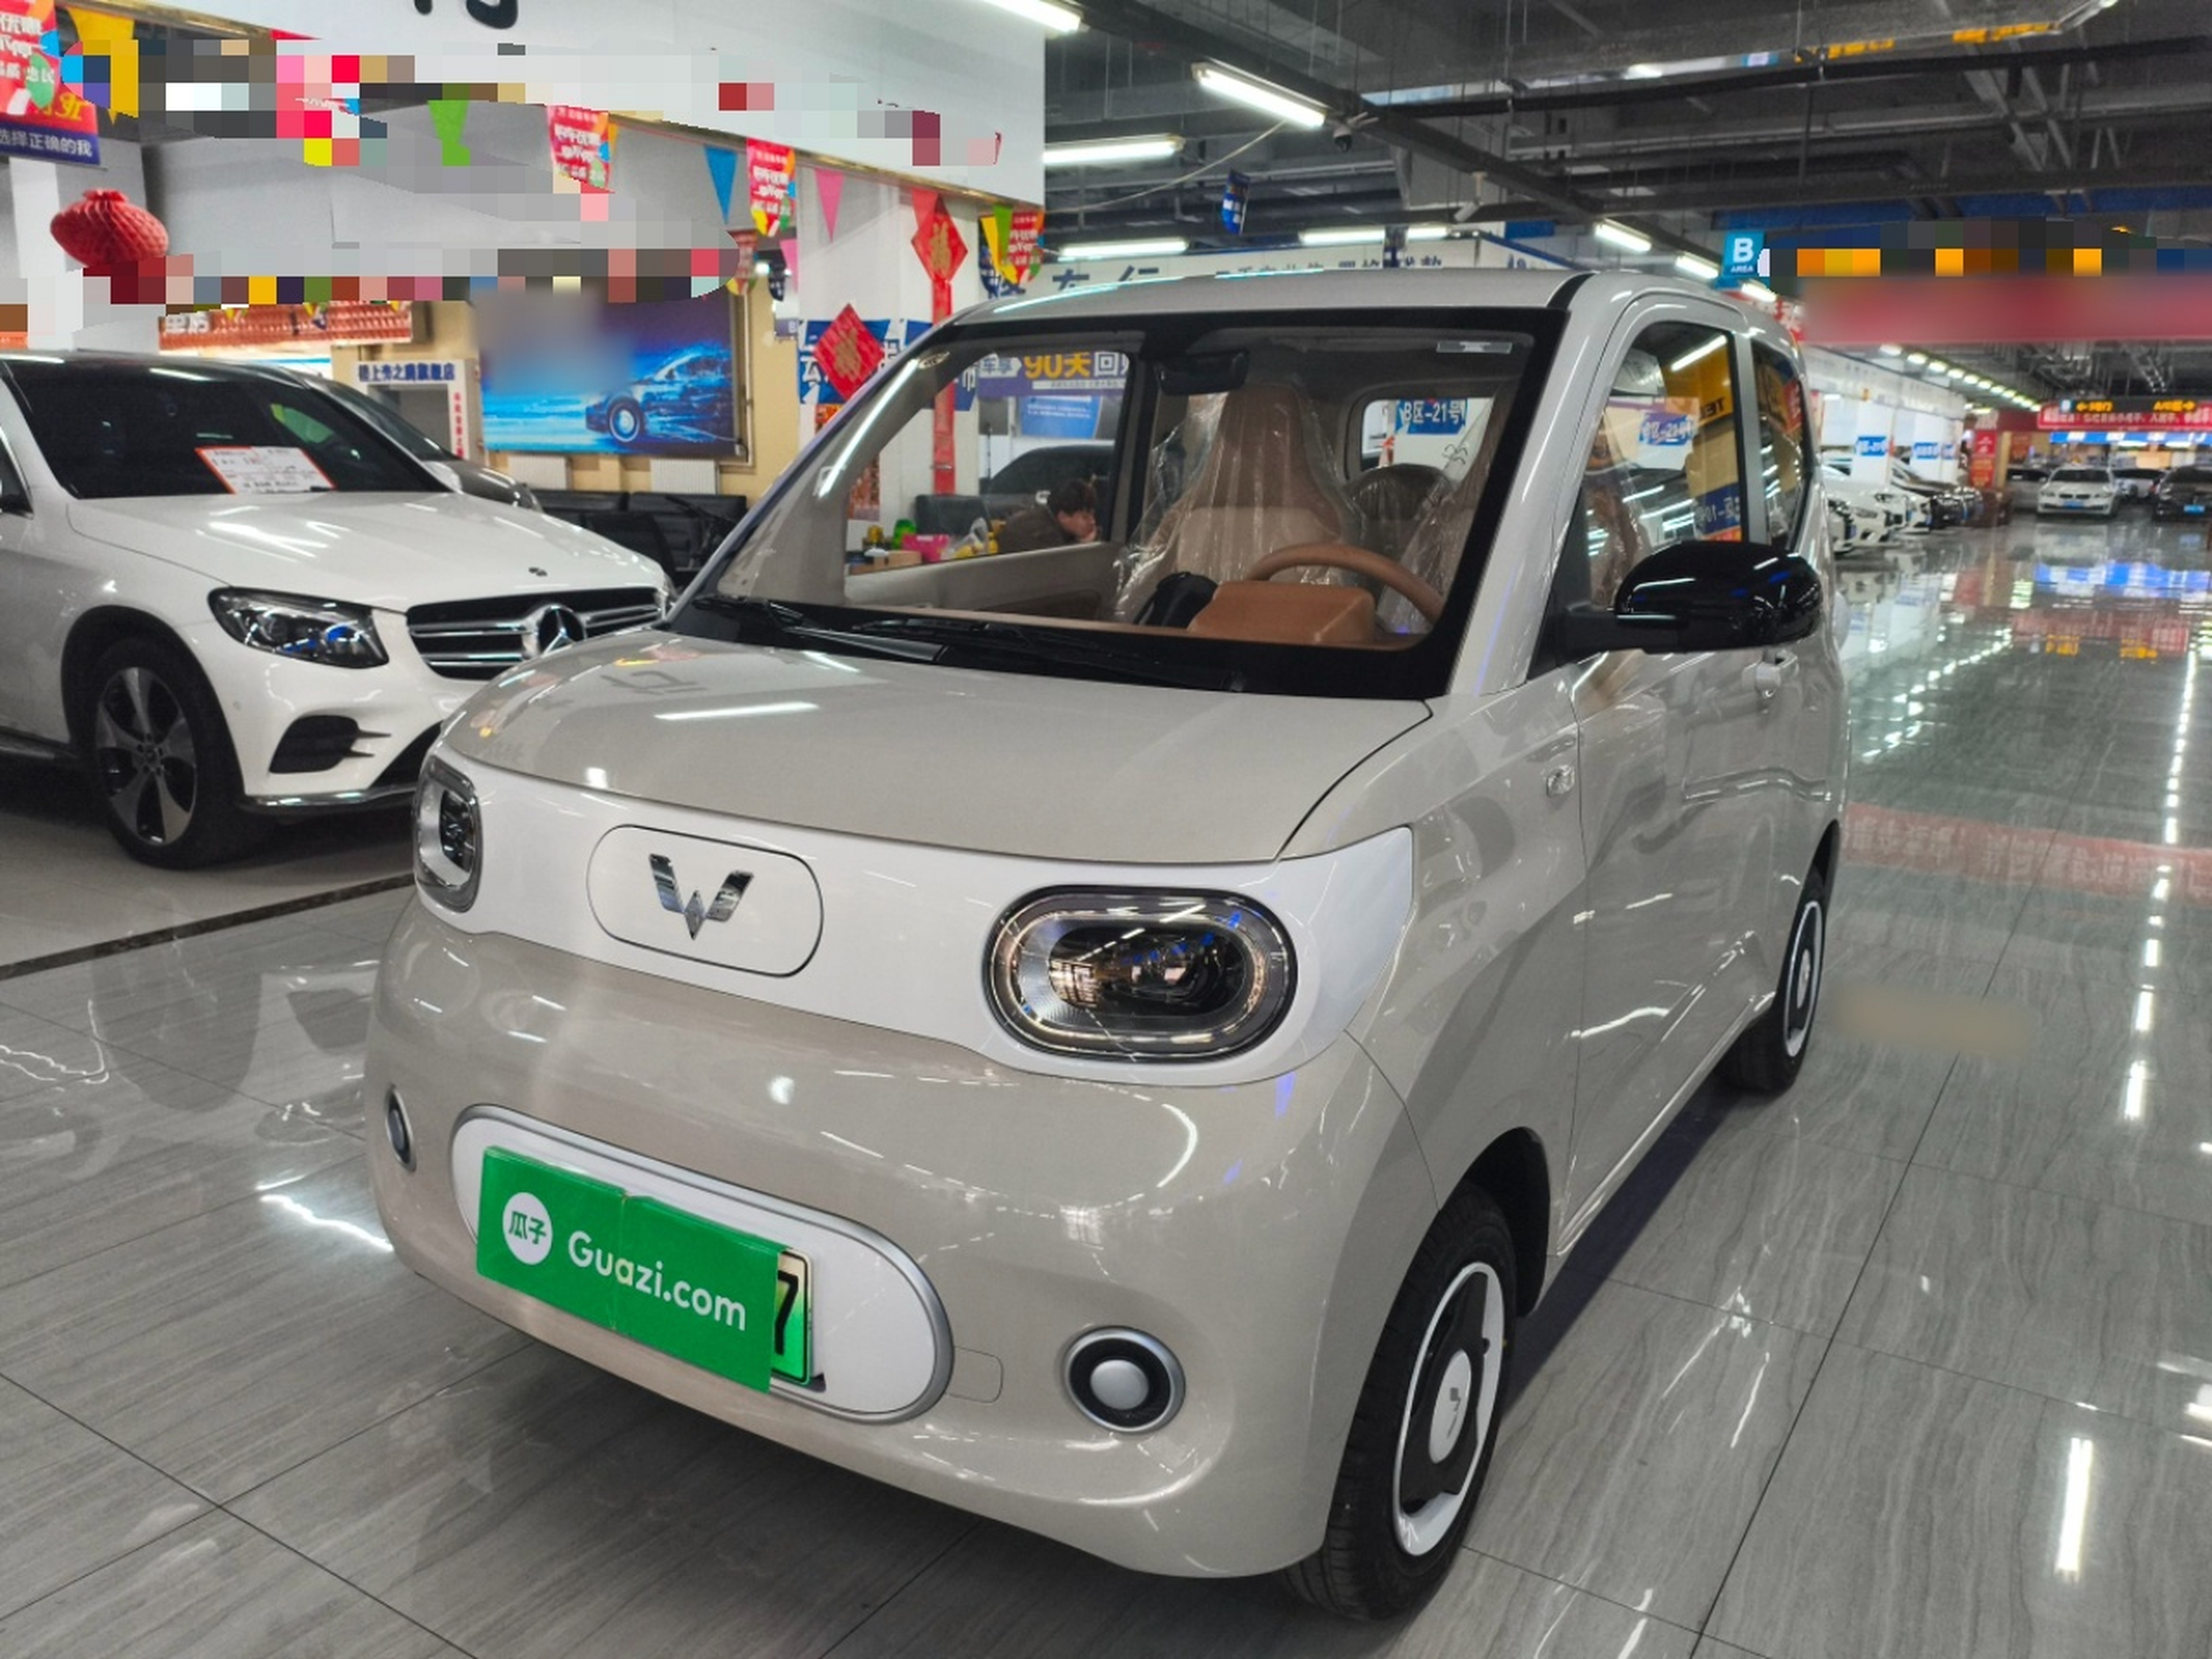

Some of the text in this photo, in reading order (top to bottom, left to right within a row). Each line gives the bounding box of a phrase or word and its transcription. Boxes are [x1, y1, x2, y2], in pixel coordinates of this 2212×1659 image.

[1733, 237, 1753, 263] B
[1404, 400, 1461, 425] B区-21号
[508, 1211, 546, 1245] 瓜子
[568, 1230, 746, 1331] Guazi.com
[775, 1270, 799, 1356] 7
